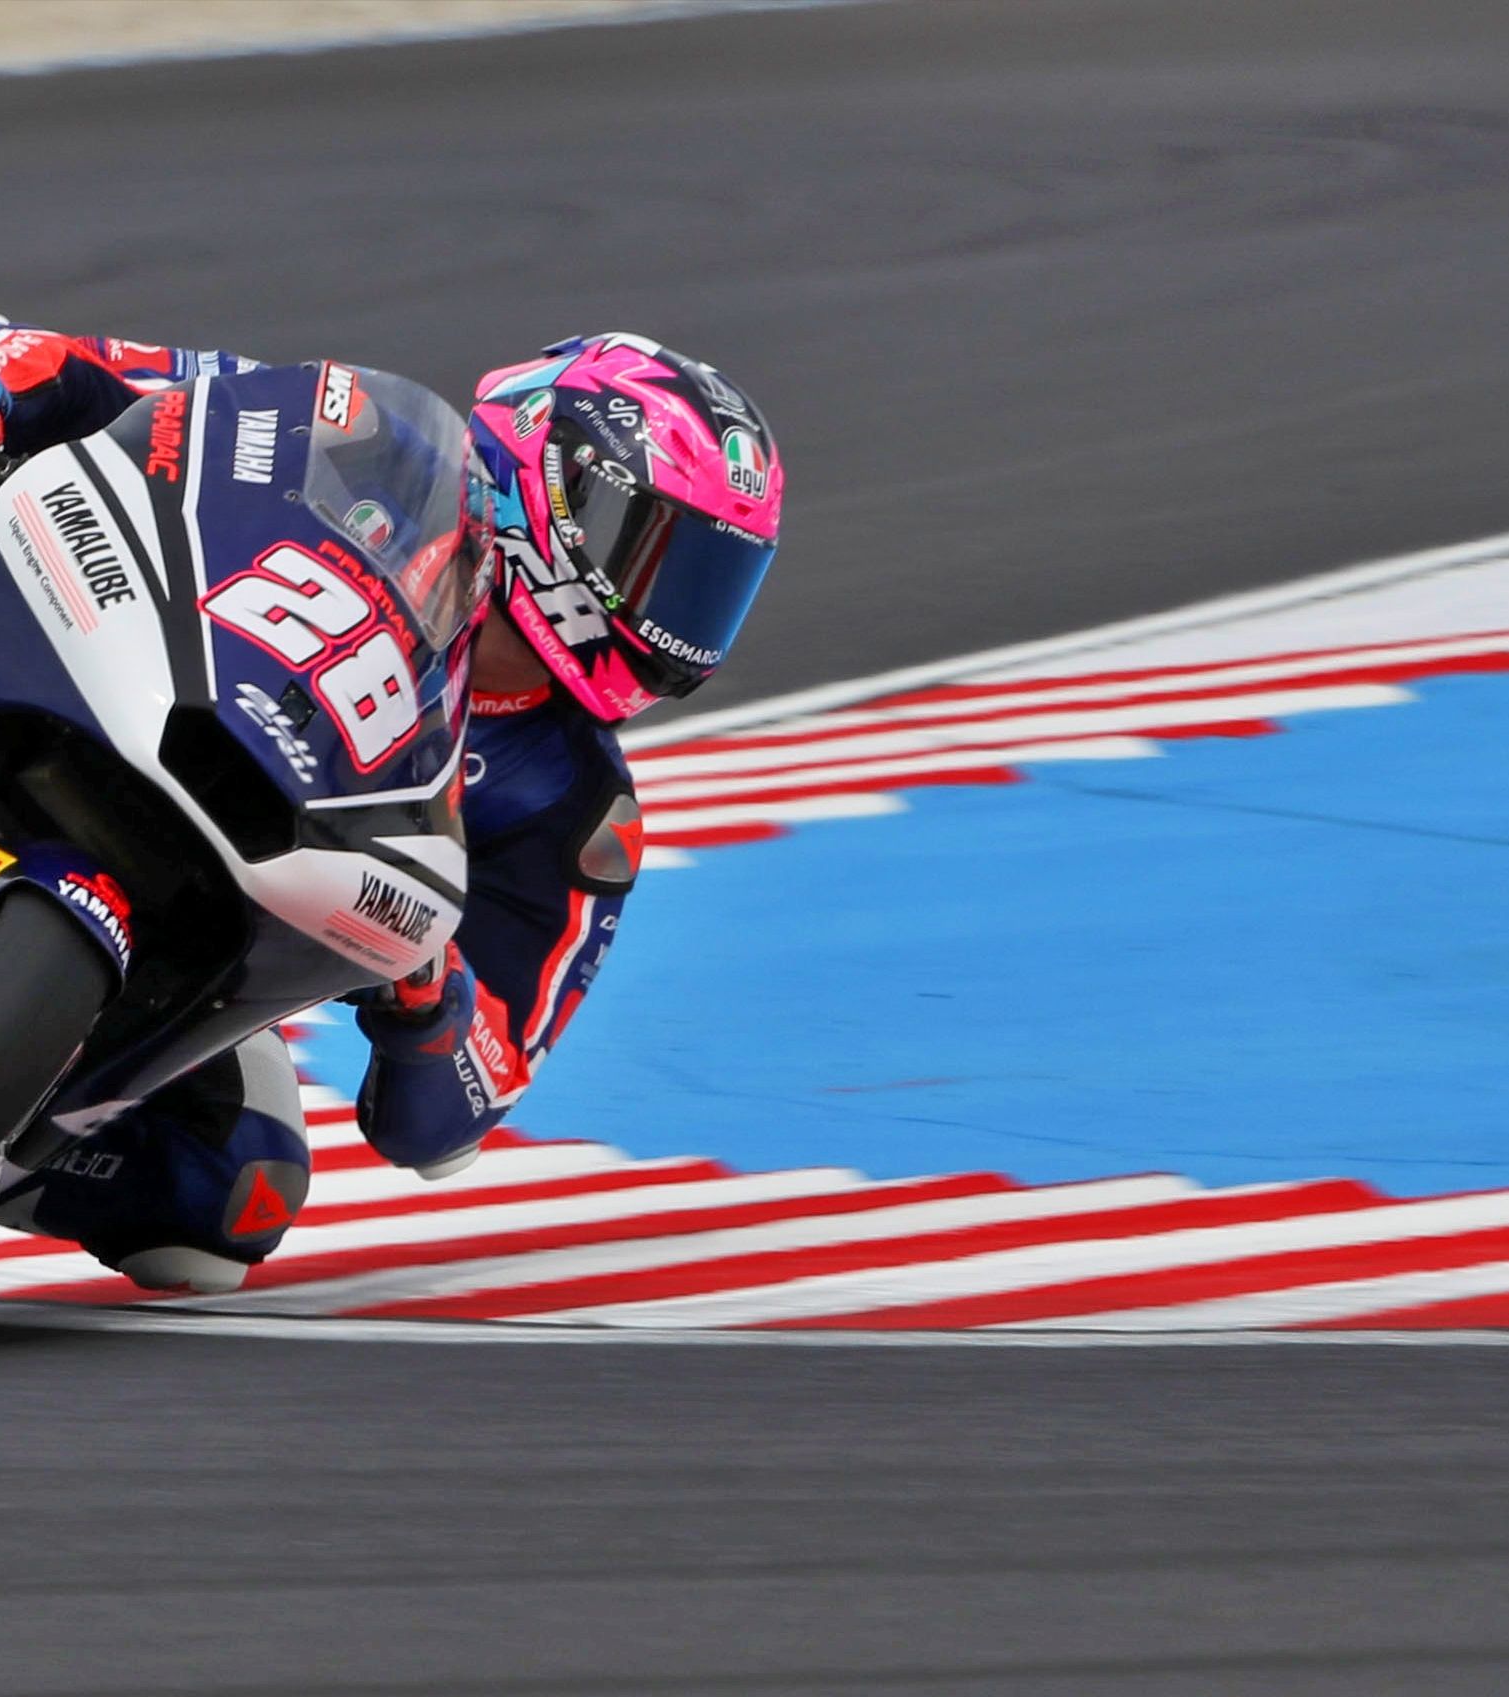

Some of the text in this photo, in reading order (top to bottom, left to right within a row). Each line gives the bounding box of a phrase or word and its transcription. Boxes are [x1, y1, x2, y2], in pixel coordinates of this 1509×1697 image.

[147, 391, 186, 482] PRAMAC
[233, 409, 279, 484] YAMAHA
[586, 409, 633, 461] Financial
[41, 481, 137, 611] YAMALUBE
[40, 575, 74, 631] Component
[317, 539, 420, 662] PRAMAC
[514, 596, 585, 681] PRAMAC
[197, 540, 423, 776] 28
[468, 695, 531, 714] AMAC
[58, 879, 131, 971] YAMAHA
[353, 870, 439, 946] YAMALUBE
